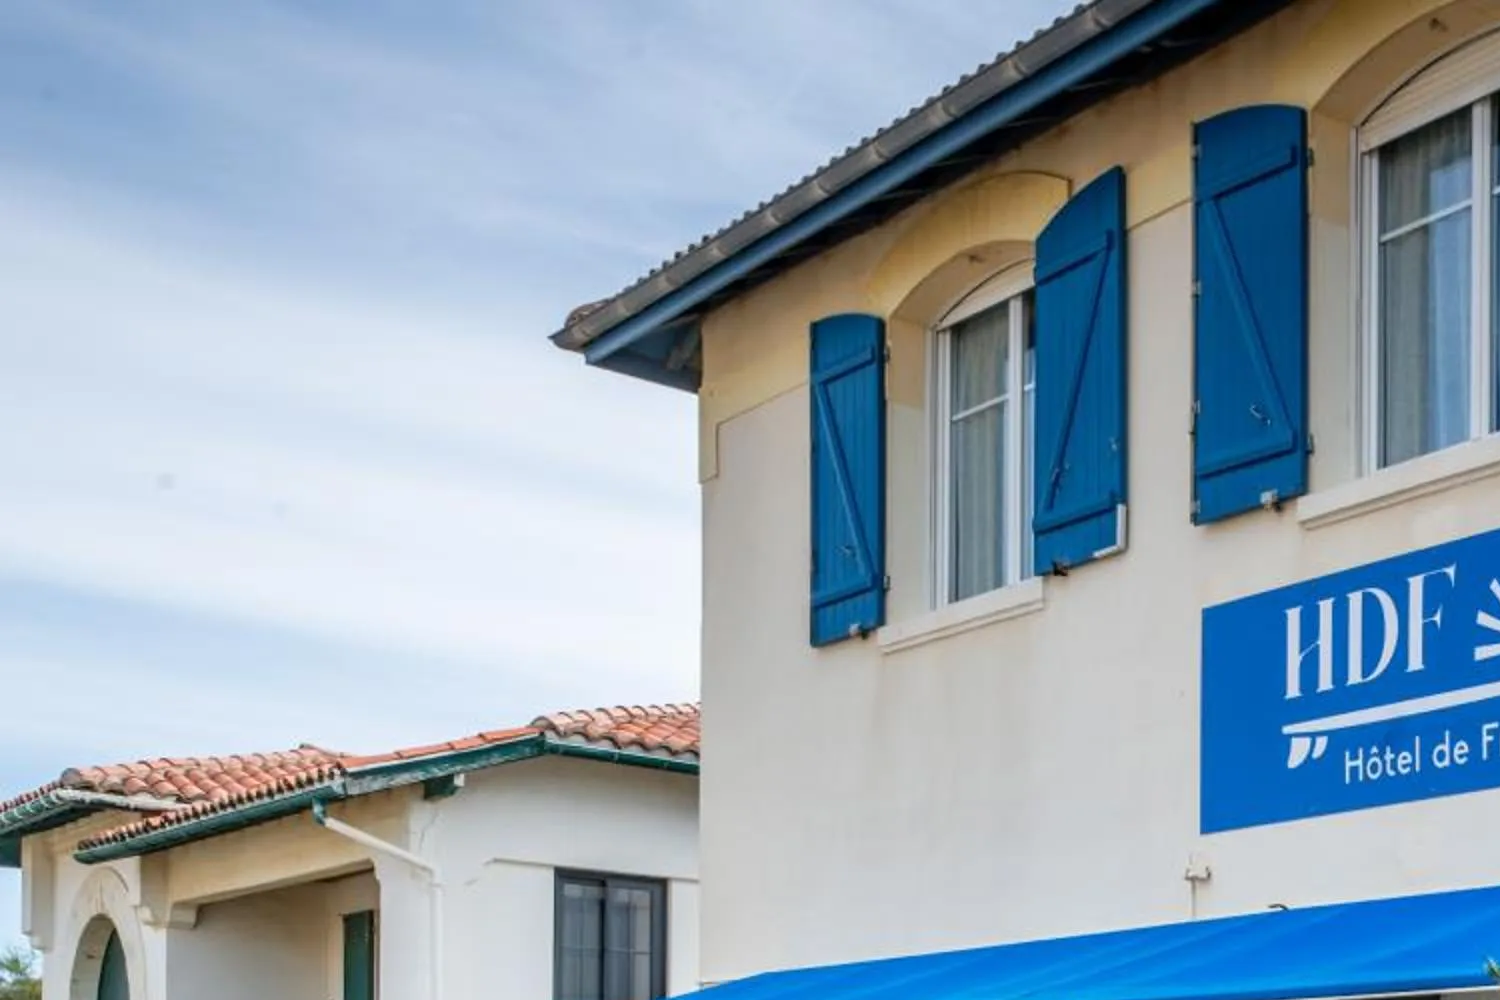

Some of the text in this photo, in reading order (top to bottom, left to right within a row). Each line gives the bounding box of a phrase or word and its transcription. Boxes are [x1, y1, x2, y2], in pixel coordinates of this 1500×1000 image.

[1284, 564, 1457, 700] HDF
[1344, 735, 1422, 785] Hôtel
[1432, 729, 1470, 769] de
